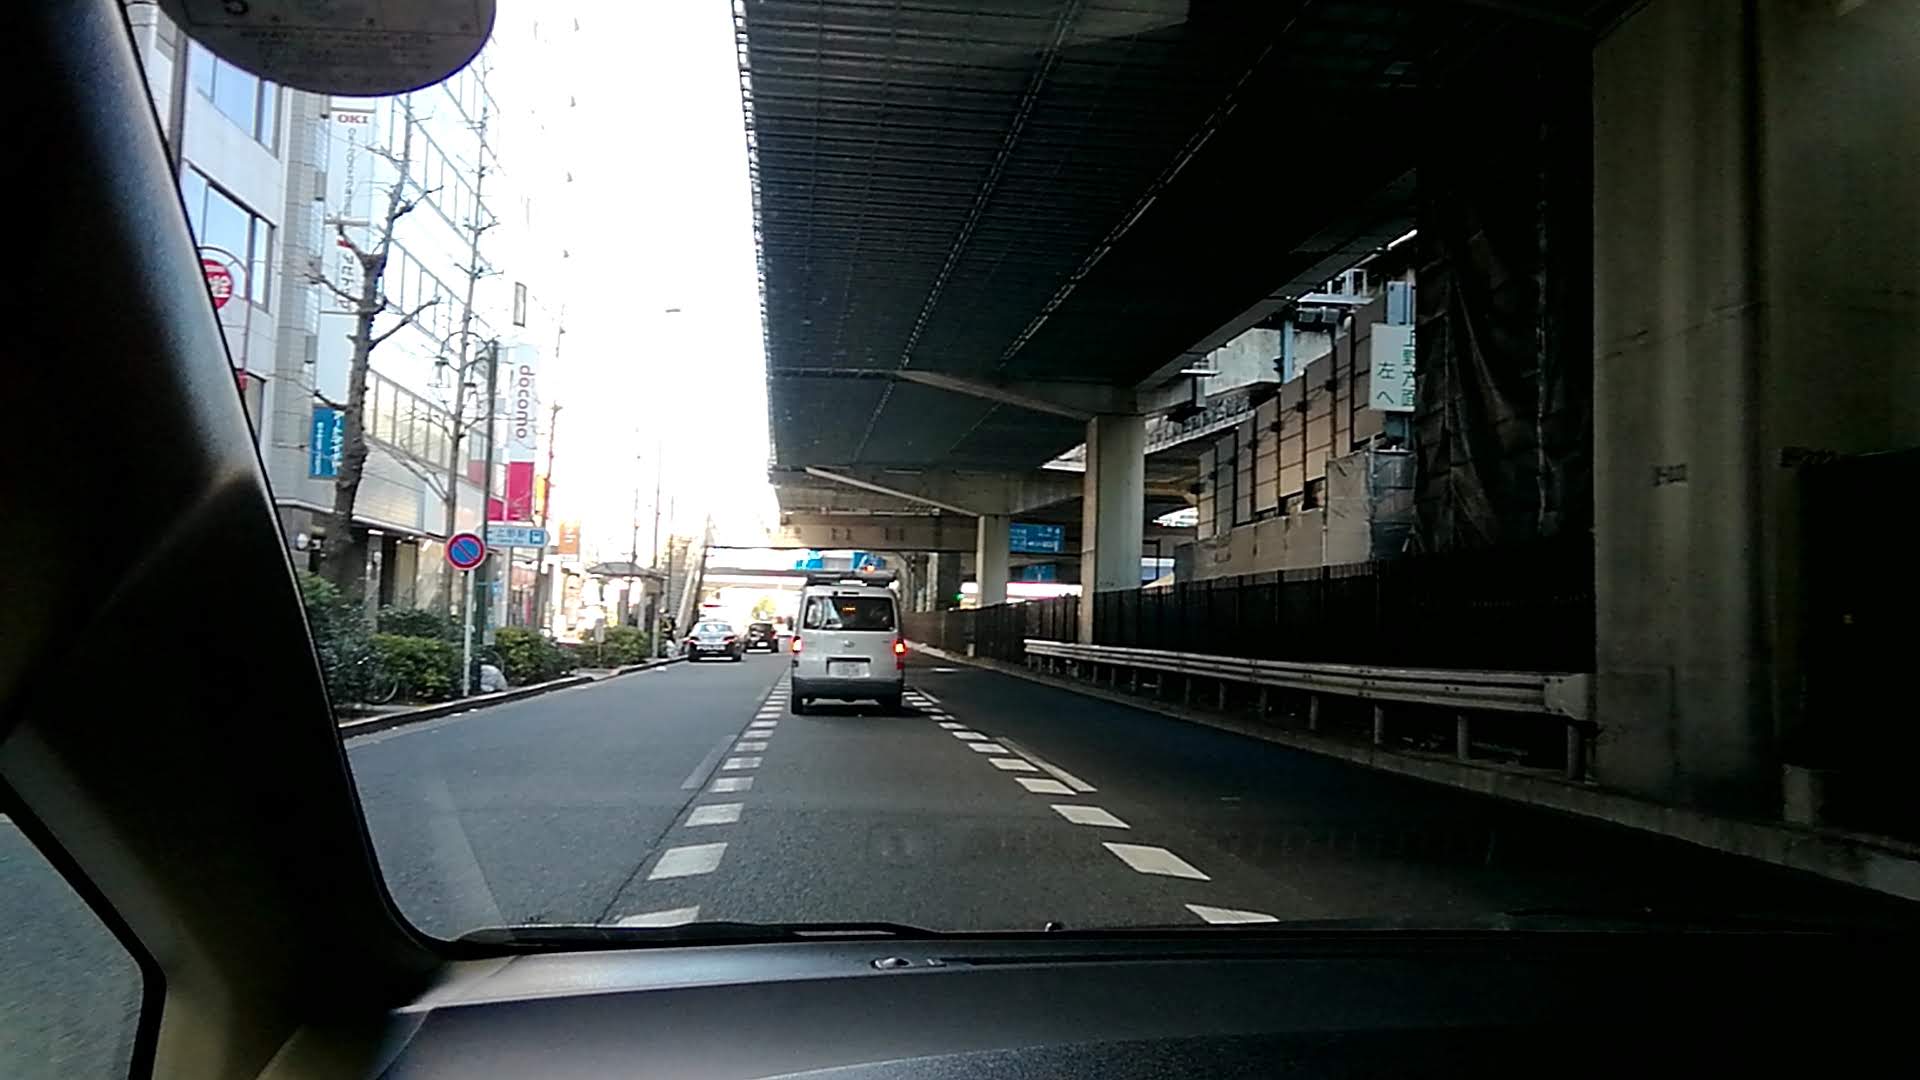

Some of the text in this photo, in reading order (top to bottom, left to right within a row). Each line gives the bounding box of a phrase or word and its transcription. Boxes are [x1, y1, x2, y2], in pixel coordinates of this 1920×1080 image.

[337, 114, 369, 124] OKI
[515, 364, 537, 440] docomo
[1377, 361, 1394, 404] 左へ
